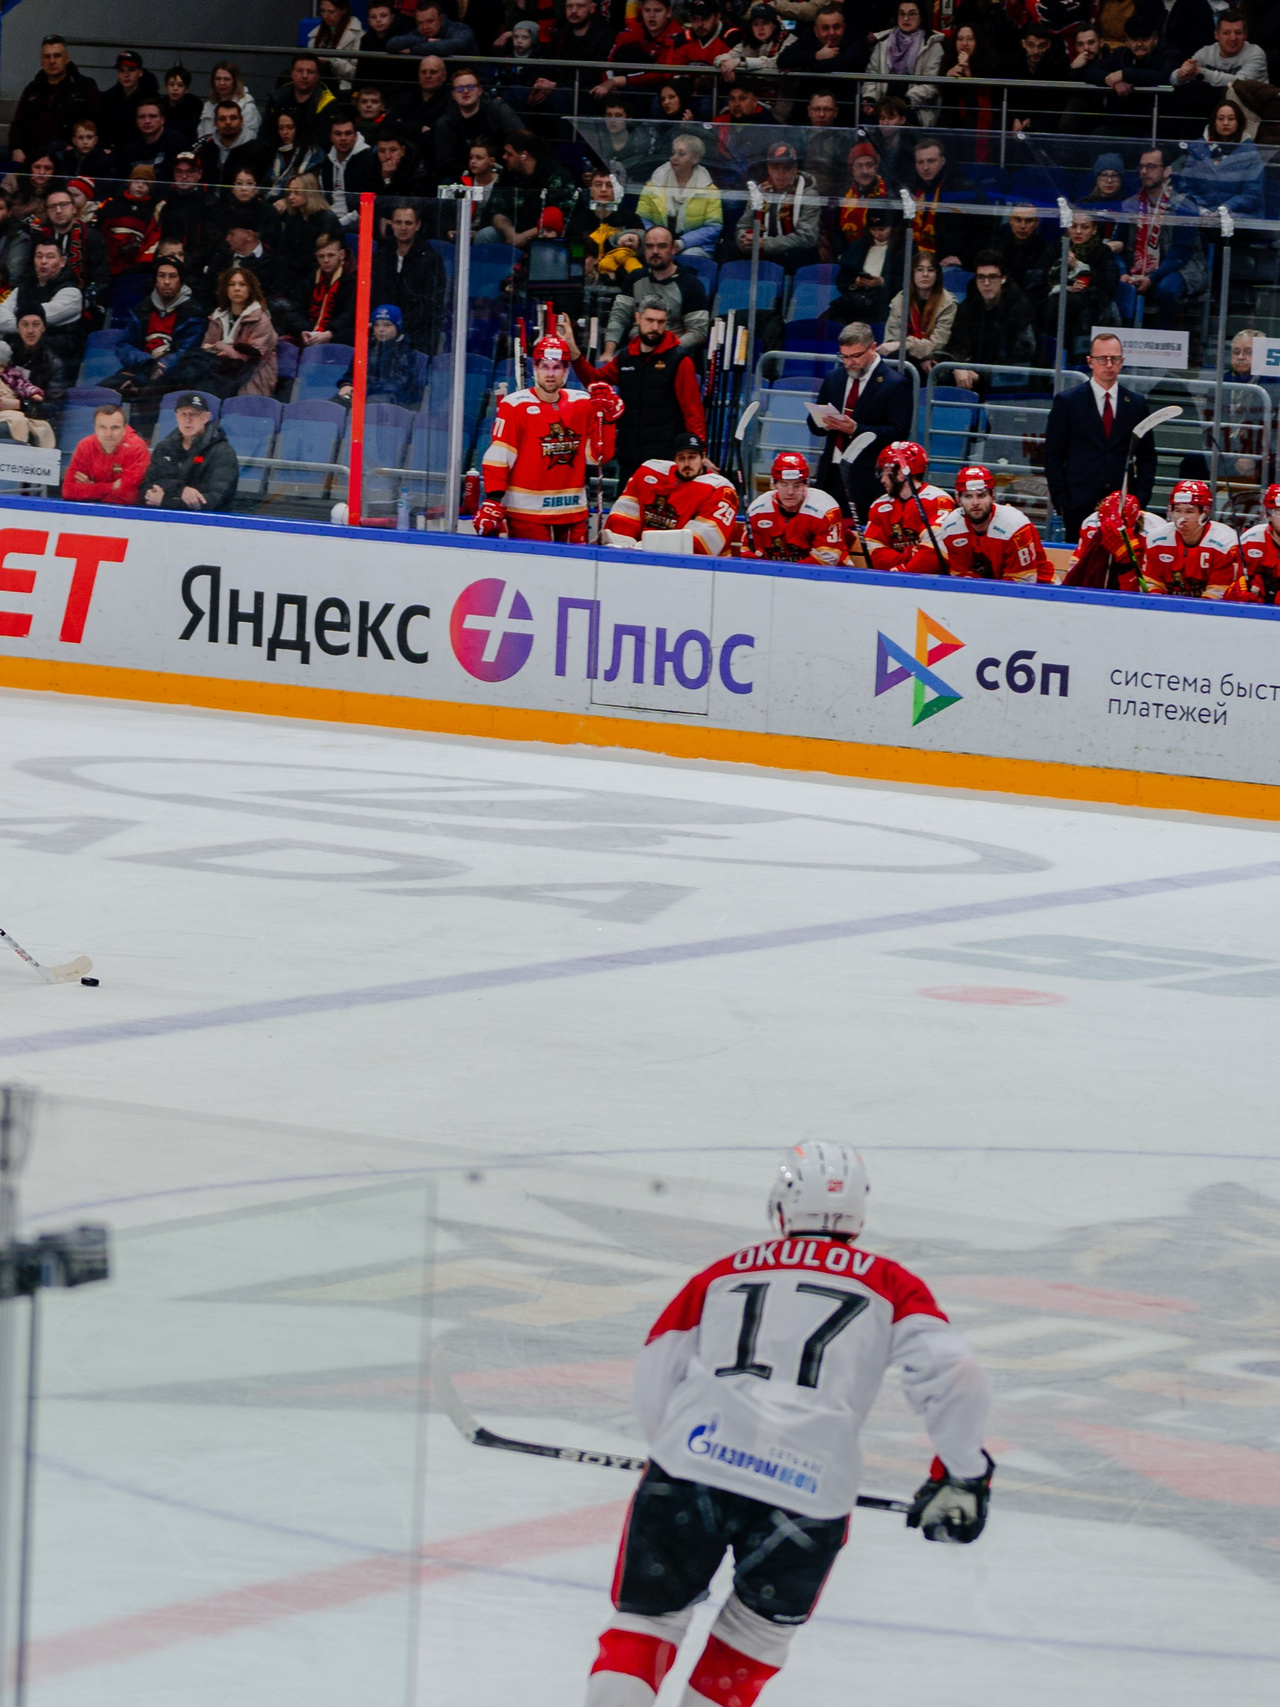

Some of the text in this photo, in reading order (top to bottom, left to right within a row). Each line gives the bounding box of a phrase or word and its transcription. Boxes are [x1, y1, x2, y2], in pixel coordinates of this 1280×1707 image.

[542, 495, 580, 508] SIBUR
[713, 501, 736, 526] 29
[1199, 552, 1210, 569] C
[178, 565, 756, 695] Яндекс Плюс
[976, 650, 1070, 697] сбп
[1110, 669, 1212, 695] система
[1108, 698, 1228, 726] платежей
[732, 1241, 876, 1276] OKULOV
[714, 1281, 870, 1389] 17
